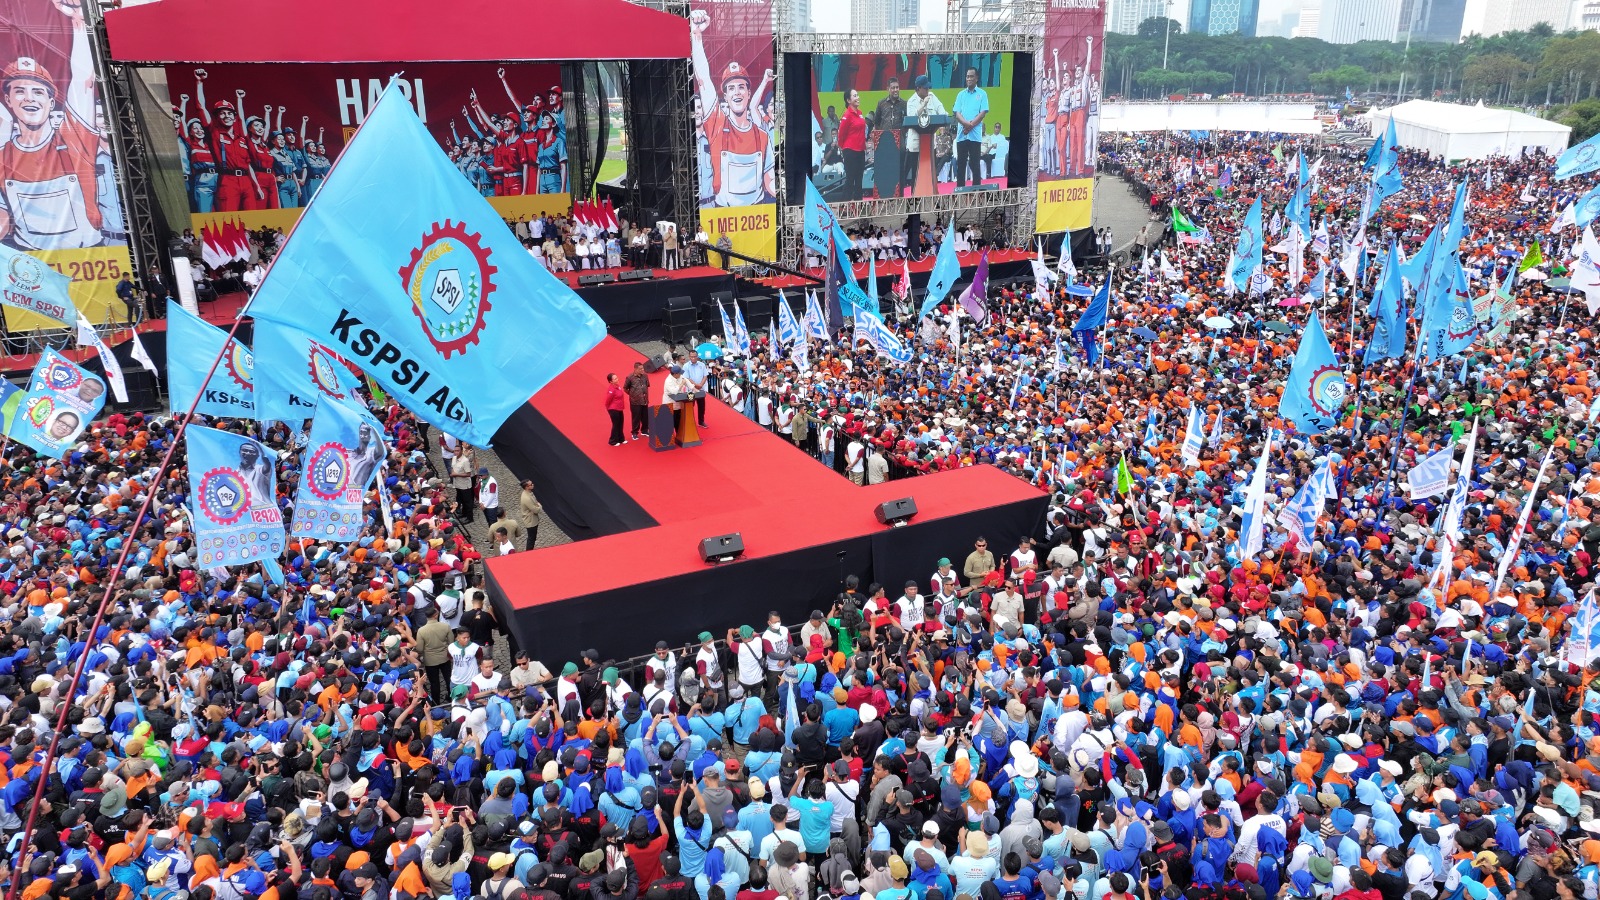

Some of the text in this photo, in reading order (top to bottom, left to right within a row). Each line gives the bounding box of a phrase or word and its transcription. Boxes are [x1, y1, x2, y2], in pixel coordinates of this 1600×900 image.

[1043, 187, 1088, 204] 1 MEI 2025
[708, 214, 770, 234] 1 MEI 2025
[68, 259, 121, 283] 2025
[436, 276, 461, 307] SPSI
[3, 289, 33, 306] LEM
[35, 300, 66, 319] SPSI
[330, 308, 430, 395] KSPSI
[1327, 383, 1342, 398] SPSI
